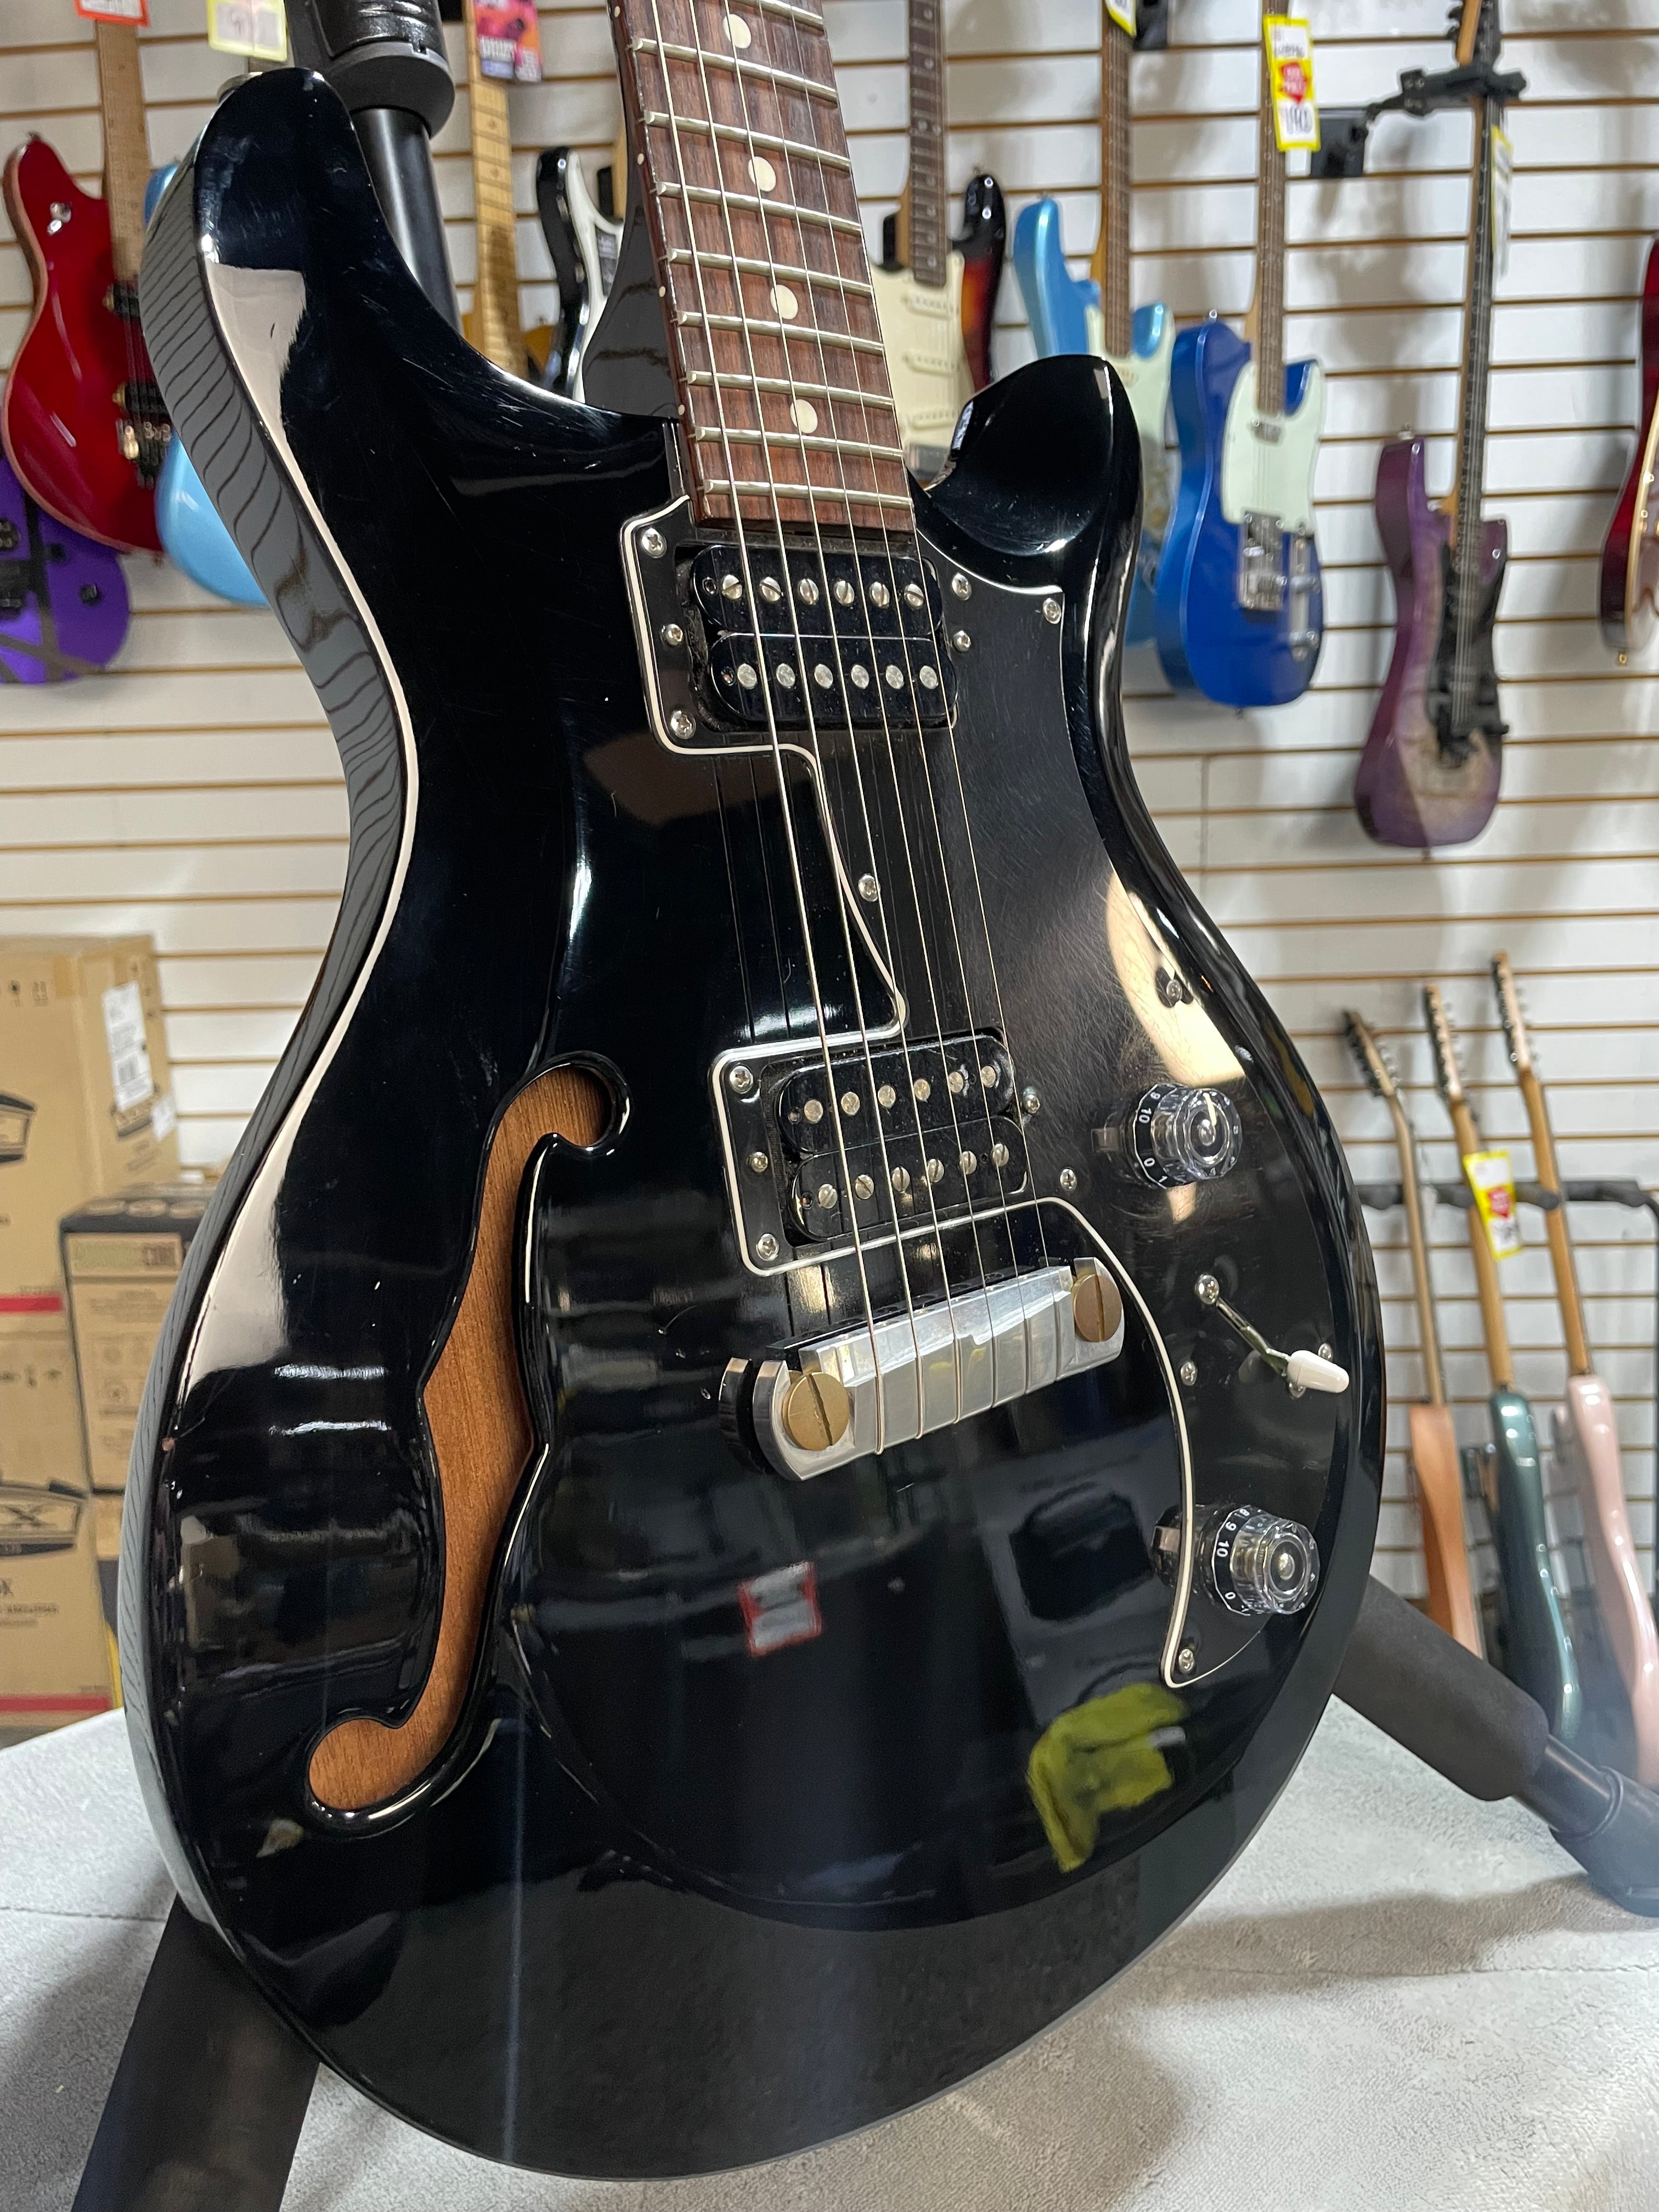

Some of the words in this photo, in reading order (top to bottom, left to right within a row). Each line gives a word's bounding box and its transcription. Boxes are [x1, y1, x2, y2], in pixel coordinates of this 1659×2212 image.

[1138, 1108, 1152, 1124] 10
[1143, 1158, 1155, 1167] 0
[1159, 1175, 1168, 1183] 1
[1225, 1521, 1237, 1531] 9
[1217, 1540, 1229, 1558] 10
[1224, 1592, 1236, 1600] 0
